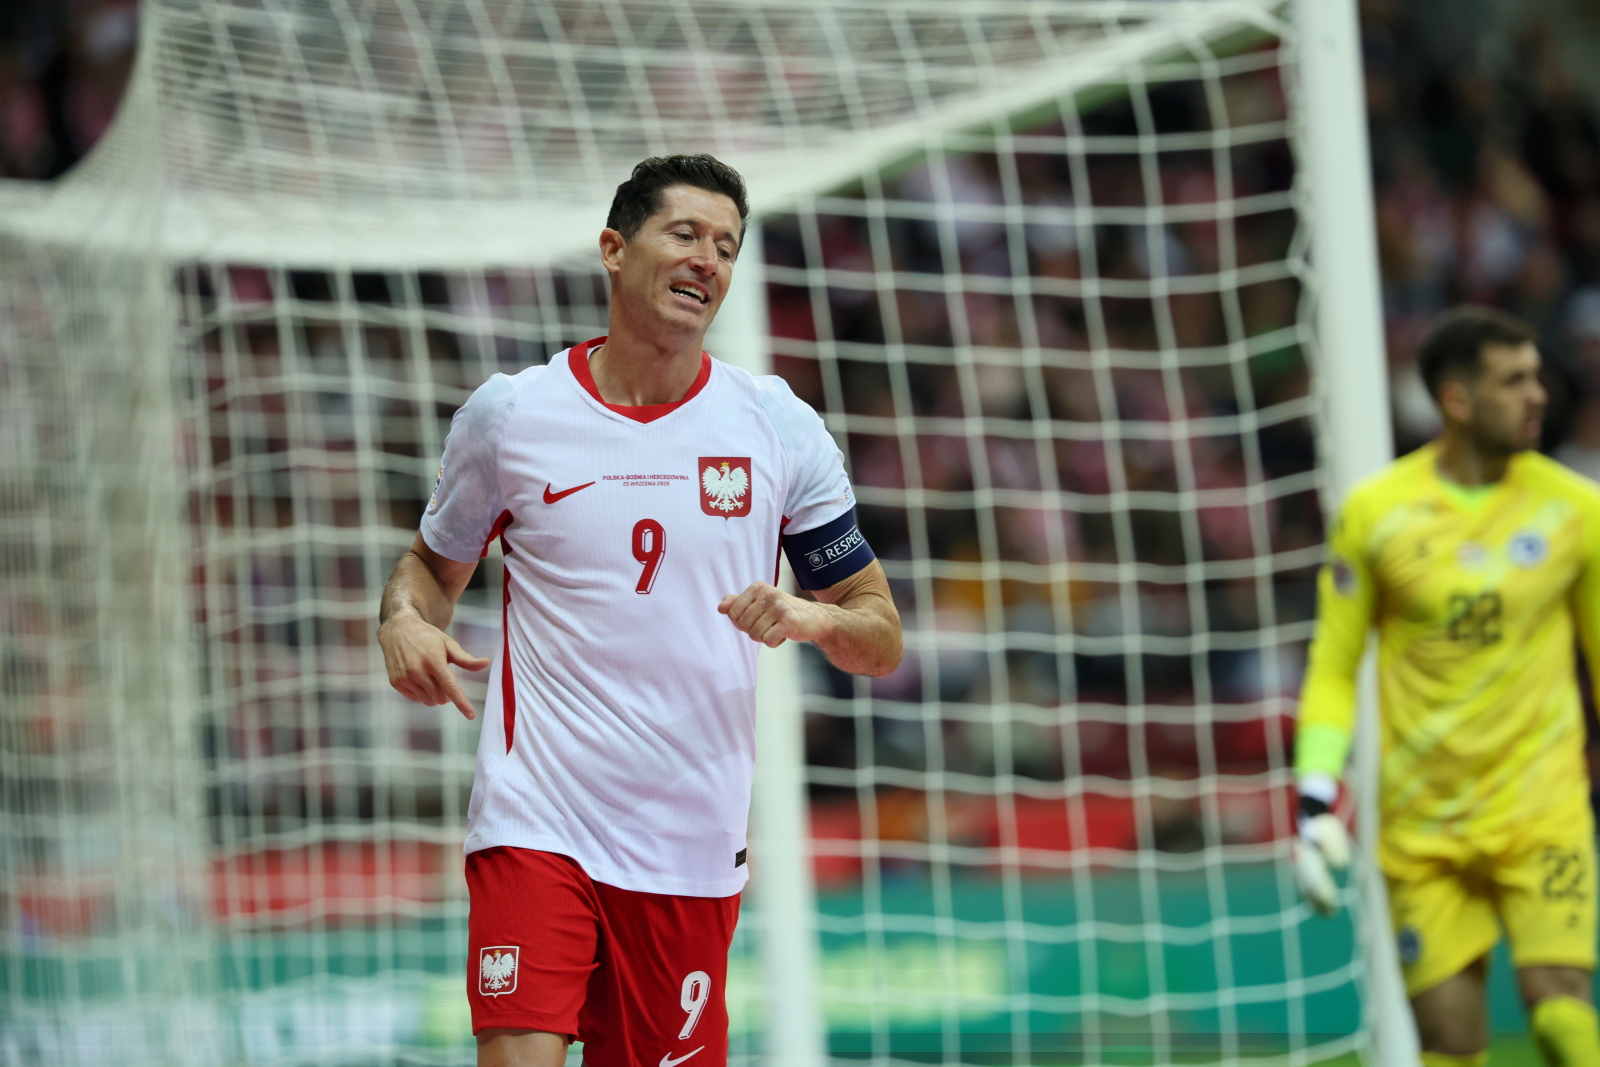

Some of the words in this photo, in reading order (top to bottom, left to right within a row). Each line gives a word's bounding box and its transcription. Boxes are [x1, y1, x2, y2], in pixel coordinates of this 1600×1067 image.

[632, 518, 666, 594] 9
[1448, 590, 1503, 647] 22
[1542, 845, 1588, 902] 22
[678, 972, 711, 1040] 9
